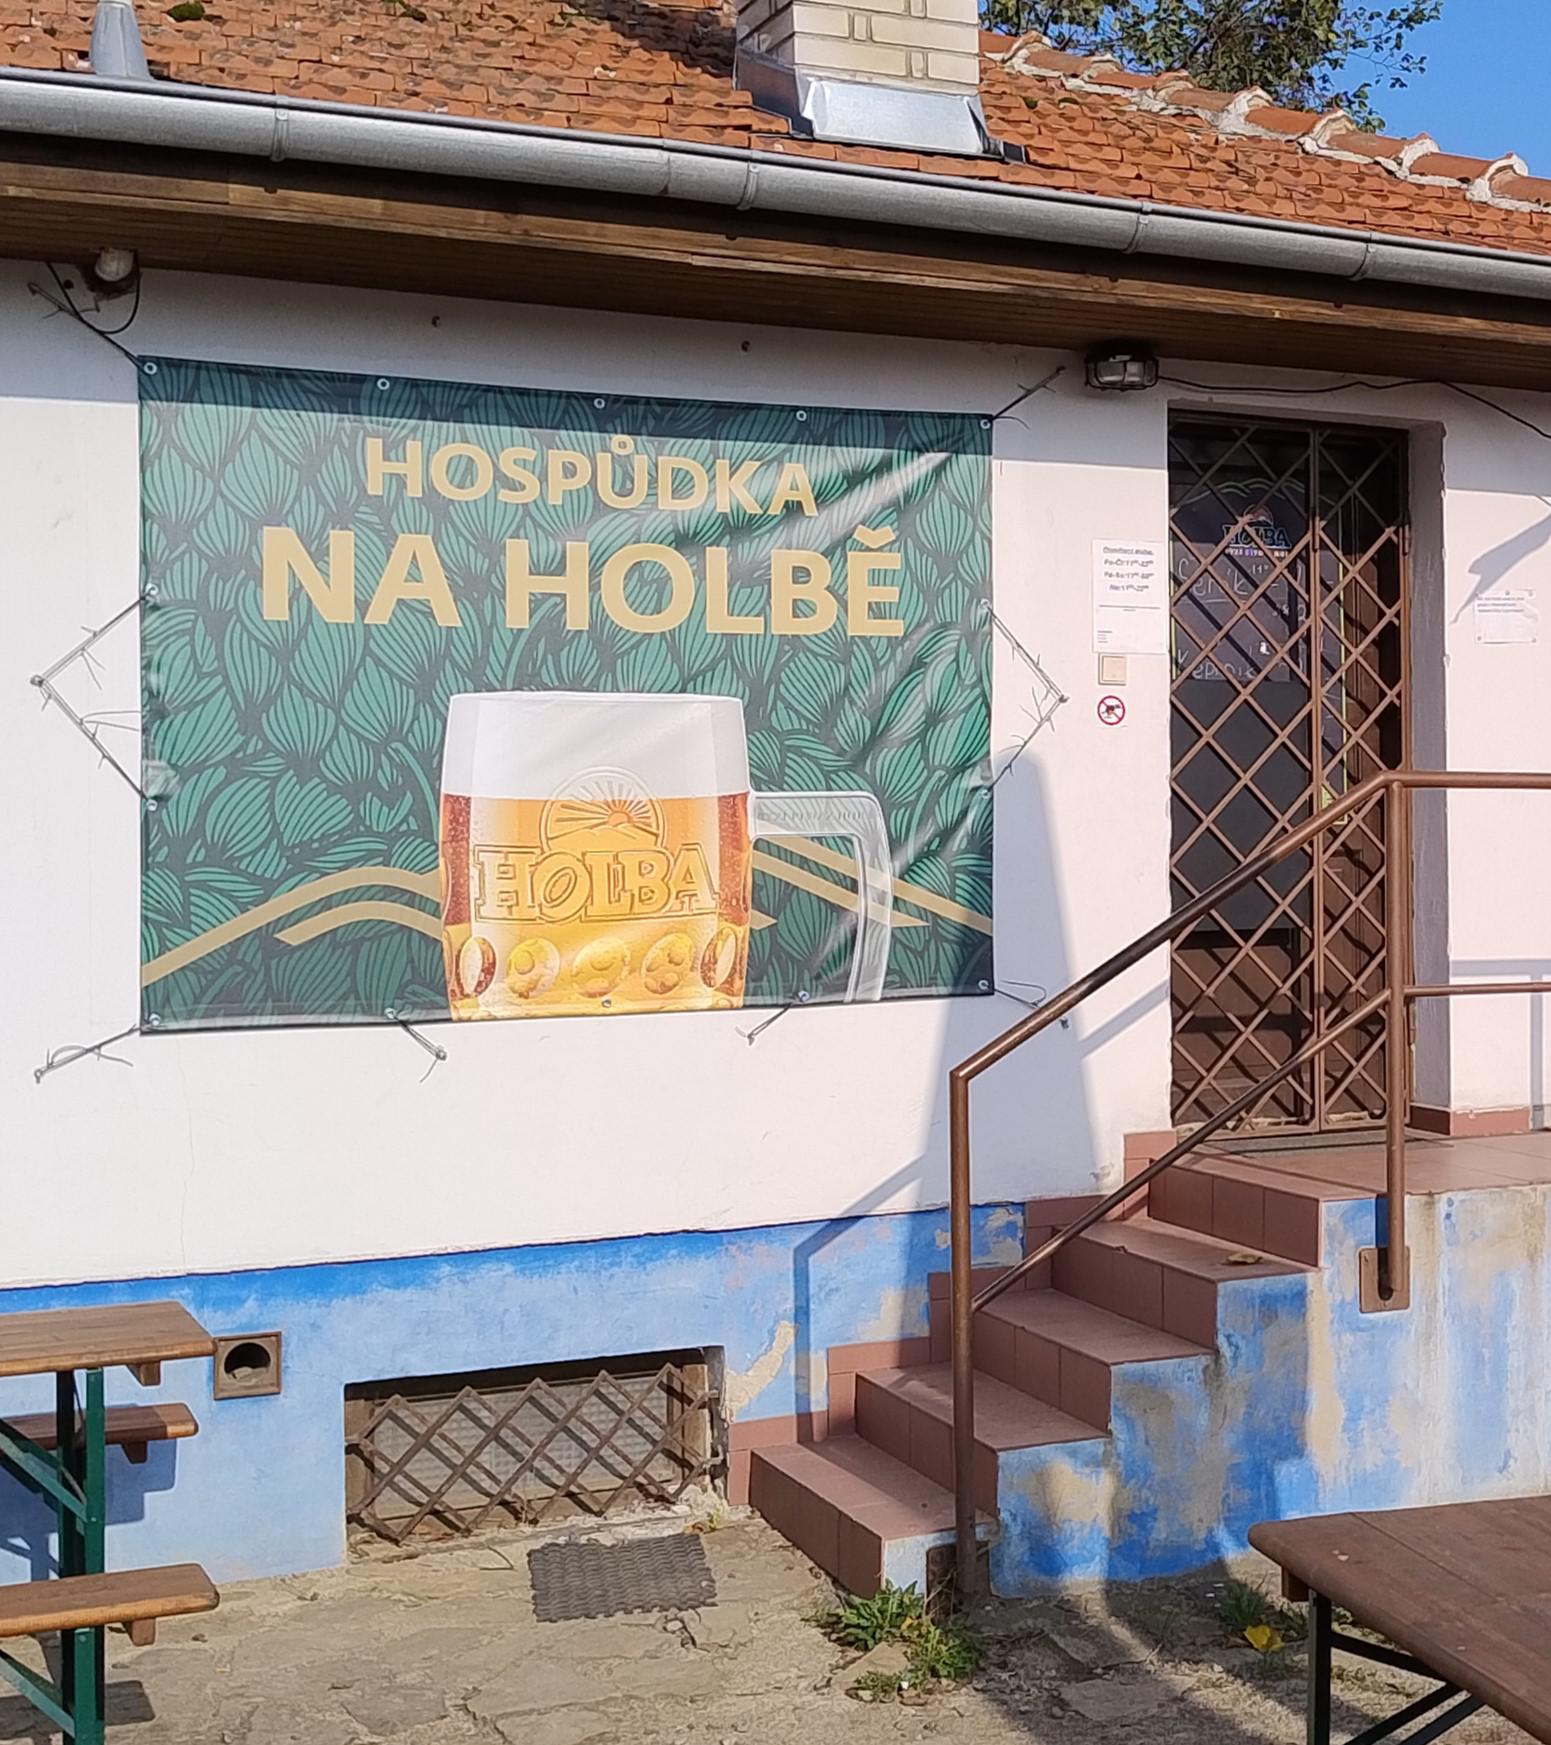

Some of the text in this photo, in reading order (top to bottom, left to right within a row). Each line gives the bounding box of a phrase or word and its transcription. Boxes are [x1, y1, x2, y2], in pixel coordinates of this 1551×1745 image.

[365, 434, 819, 516] HOSPŮDKA
[261, 526, 903, 637] NA HOLBĚ
[475, 845, 720, 924] HOLBA
